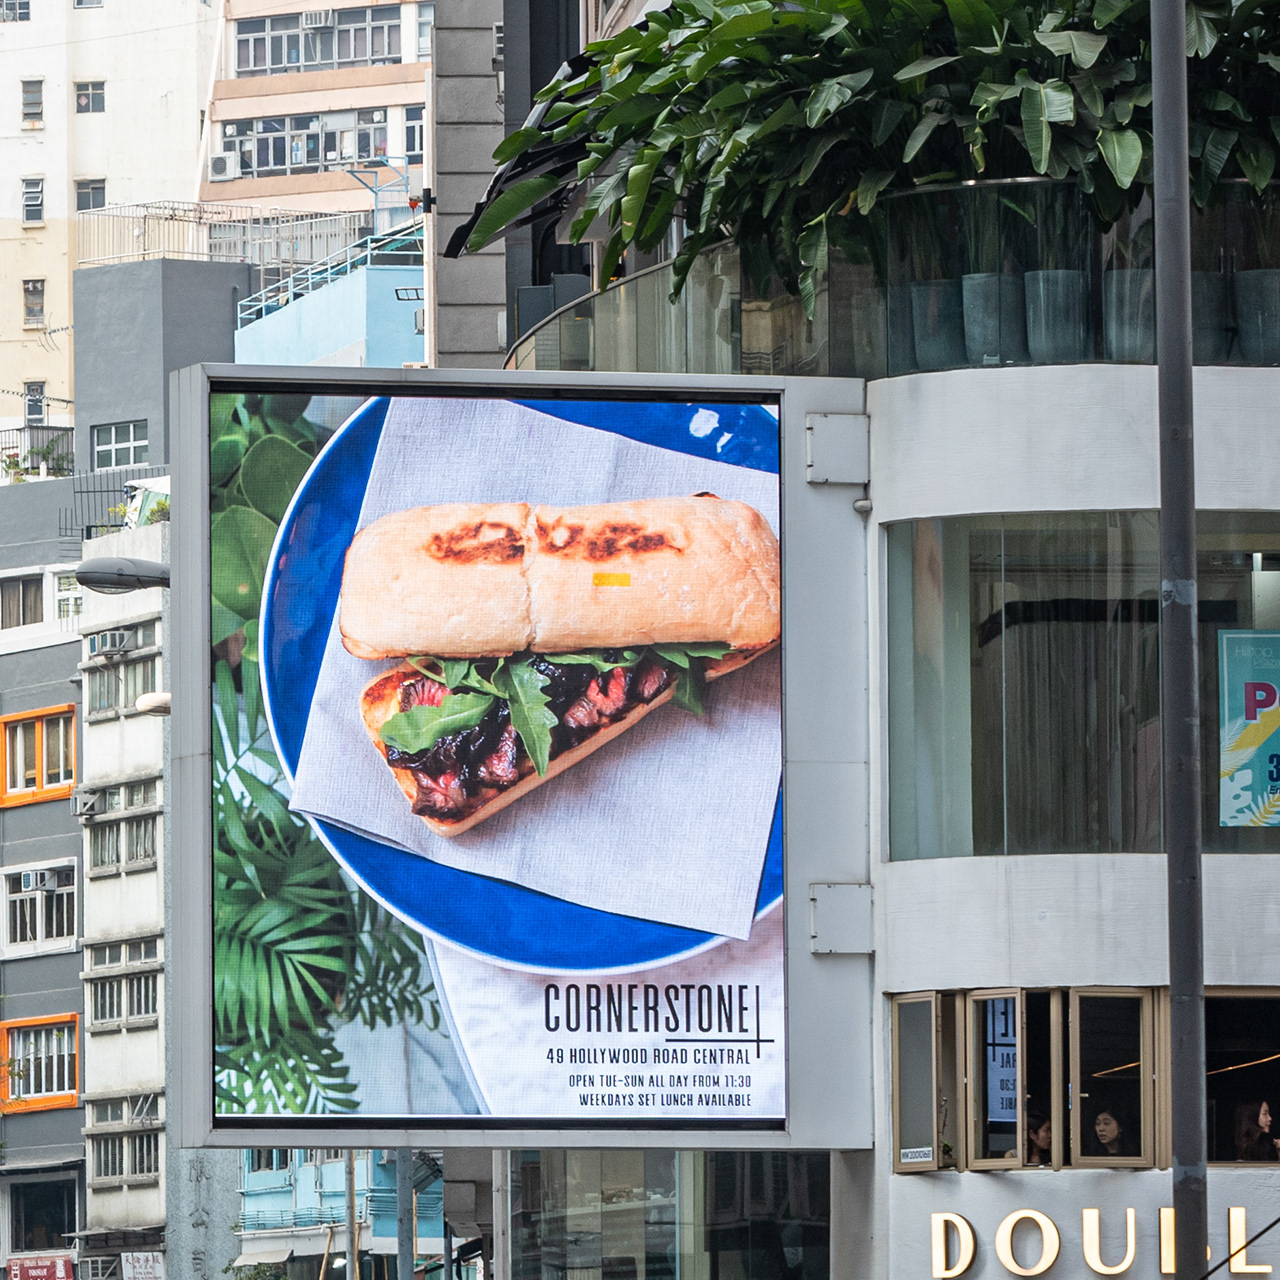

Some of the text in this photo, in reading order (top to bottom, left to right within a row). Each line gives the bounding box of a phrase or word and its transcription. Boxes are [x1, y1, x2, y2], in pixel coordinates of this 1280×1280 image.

[1244, 681, 1280, 721] P
[544, 984, 749, 1033] CORNERSTONE
[546, 1048, 751, 1064] 49 HOLLYWOOD ROAD CENTRAL
[569, 1075, 752, 1088] OPEN TUE-SUN ALL DAY FROM 11:30
[579, 1093, 752, 1107] WEEKDAYS SET LUNCH AVAILABLE
